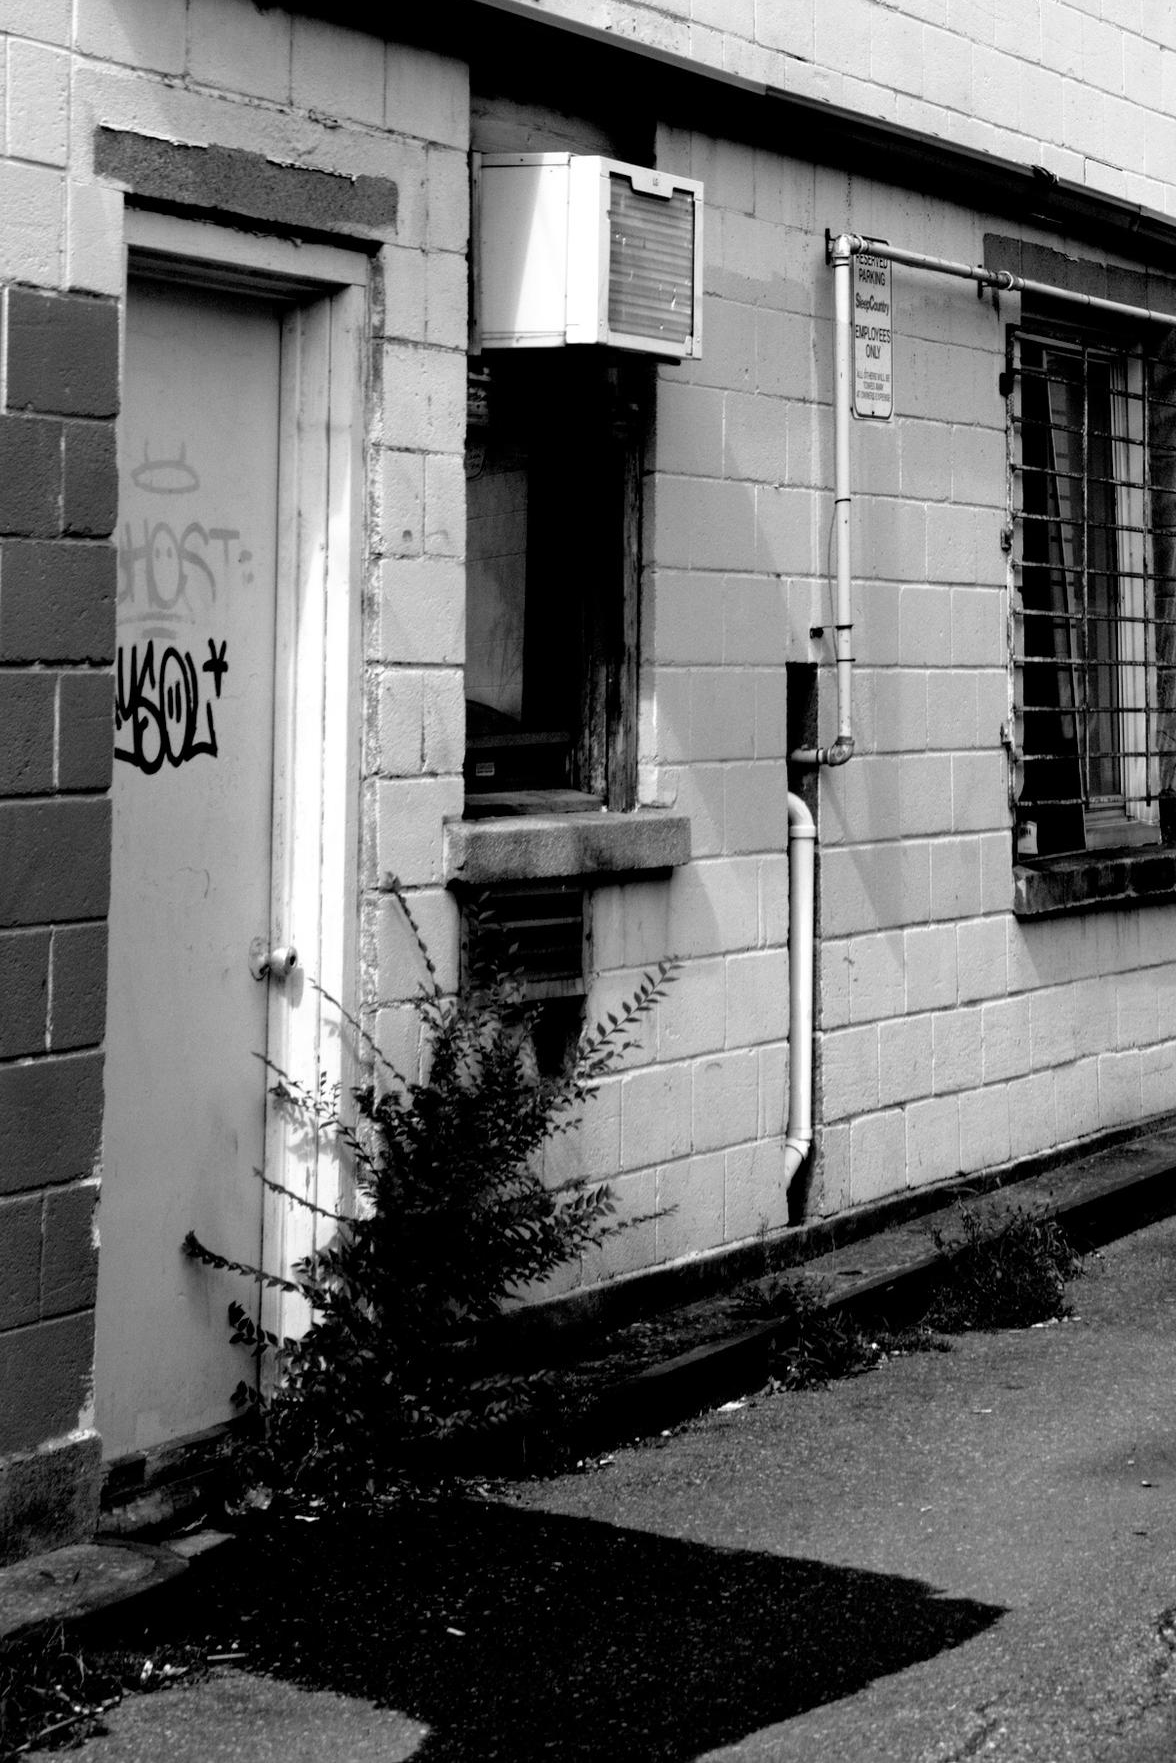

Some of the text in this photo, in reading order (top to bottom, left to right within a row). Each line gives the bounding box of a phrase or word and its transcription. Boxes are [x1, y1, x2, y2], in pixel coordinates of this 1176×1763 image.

[856, 254, 889, 269] RESERVED
[858, 268, 886, 286] PARKING
[855, 324, 891, 343] EMPLOYEES
[865, 344, 881, 359] ONLY
